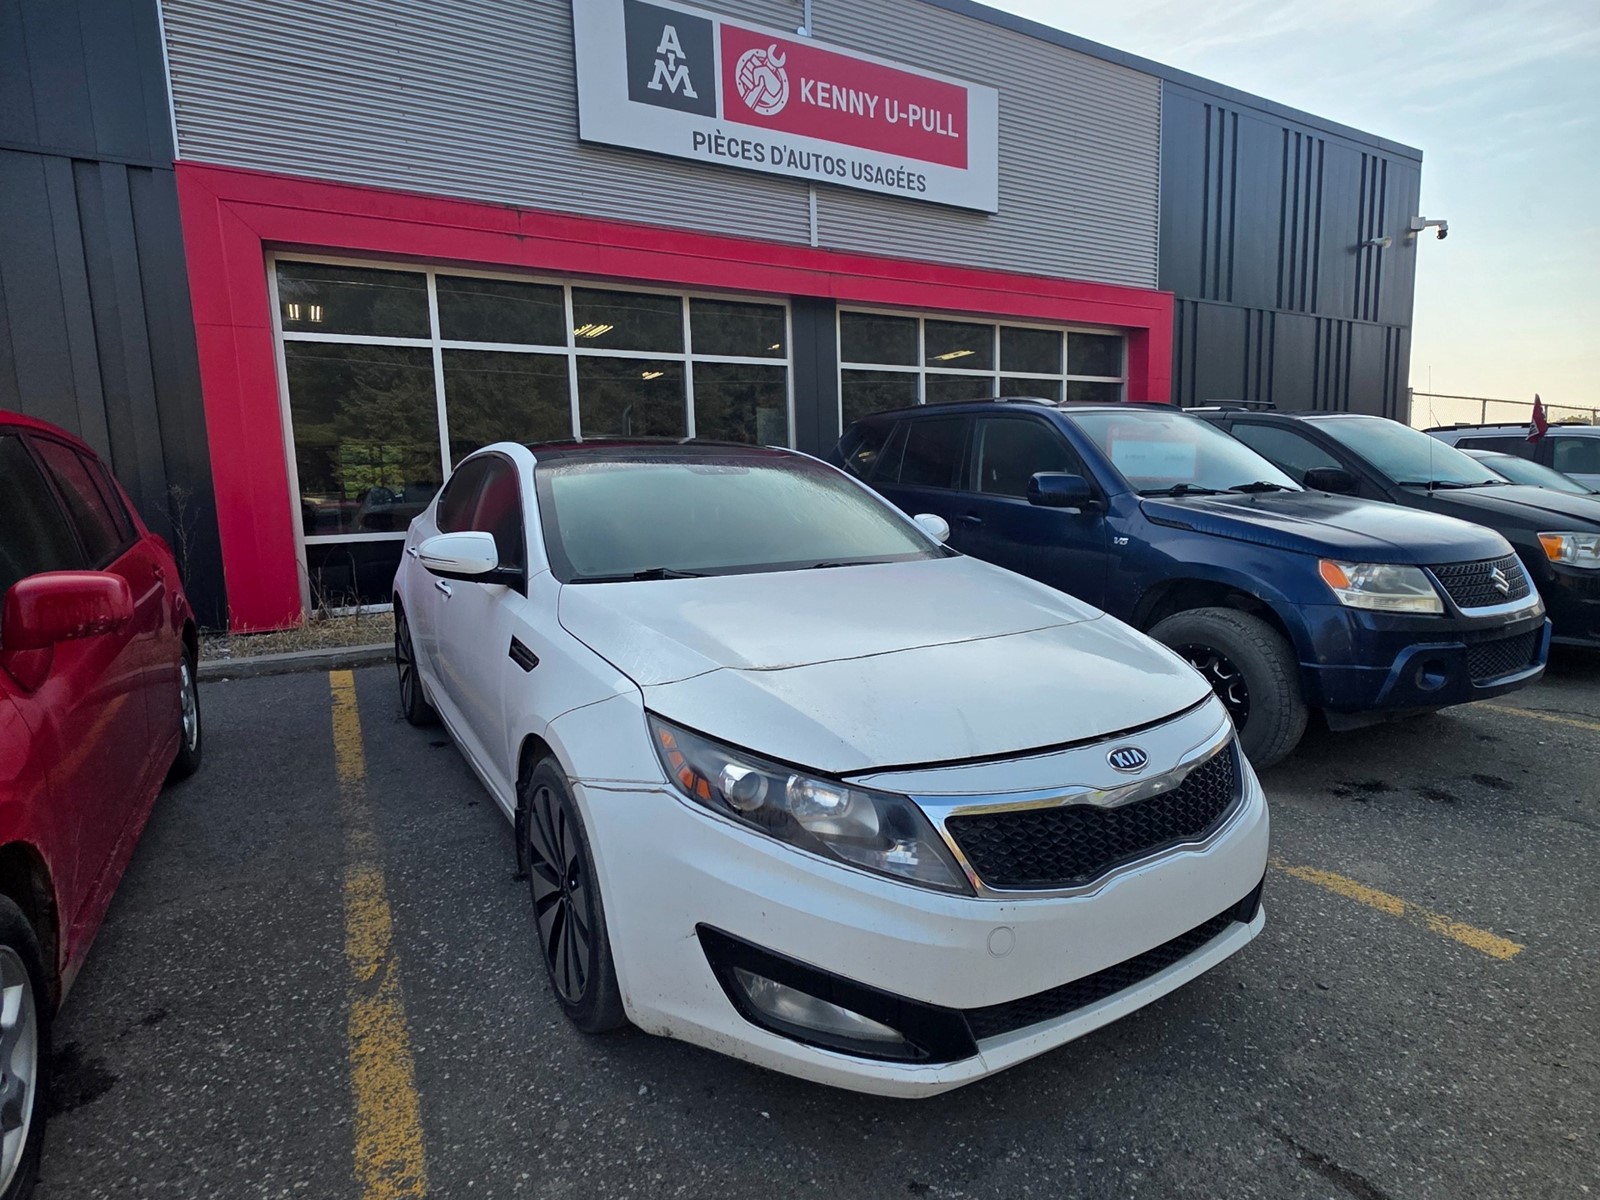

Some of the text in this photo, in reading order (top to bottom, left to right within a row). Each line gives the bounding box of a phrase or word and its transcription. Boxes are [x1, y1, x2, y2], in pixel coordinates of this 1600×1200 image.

[800, 77, 959, 138] KENNY U-PULL
[692, 128, 927, 193] PIÈCES D'AUTOS USAGÉES
[1113, 536, 1129, 546] V6
[1112, 749, 1146, 768] KIA
